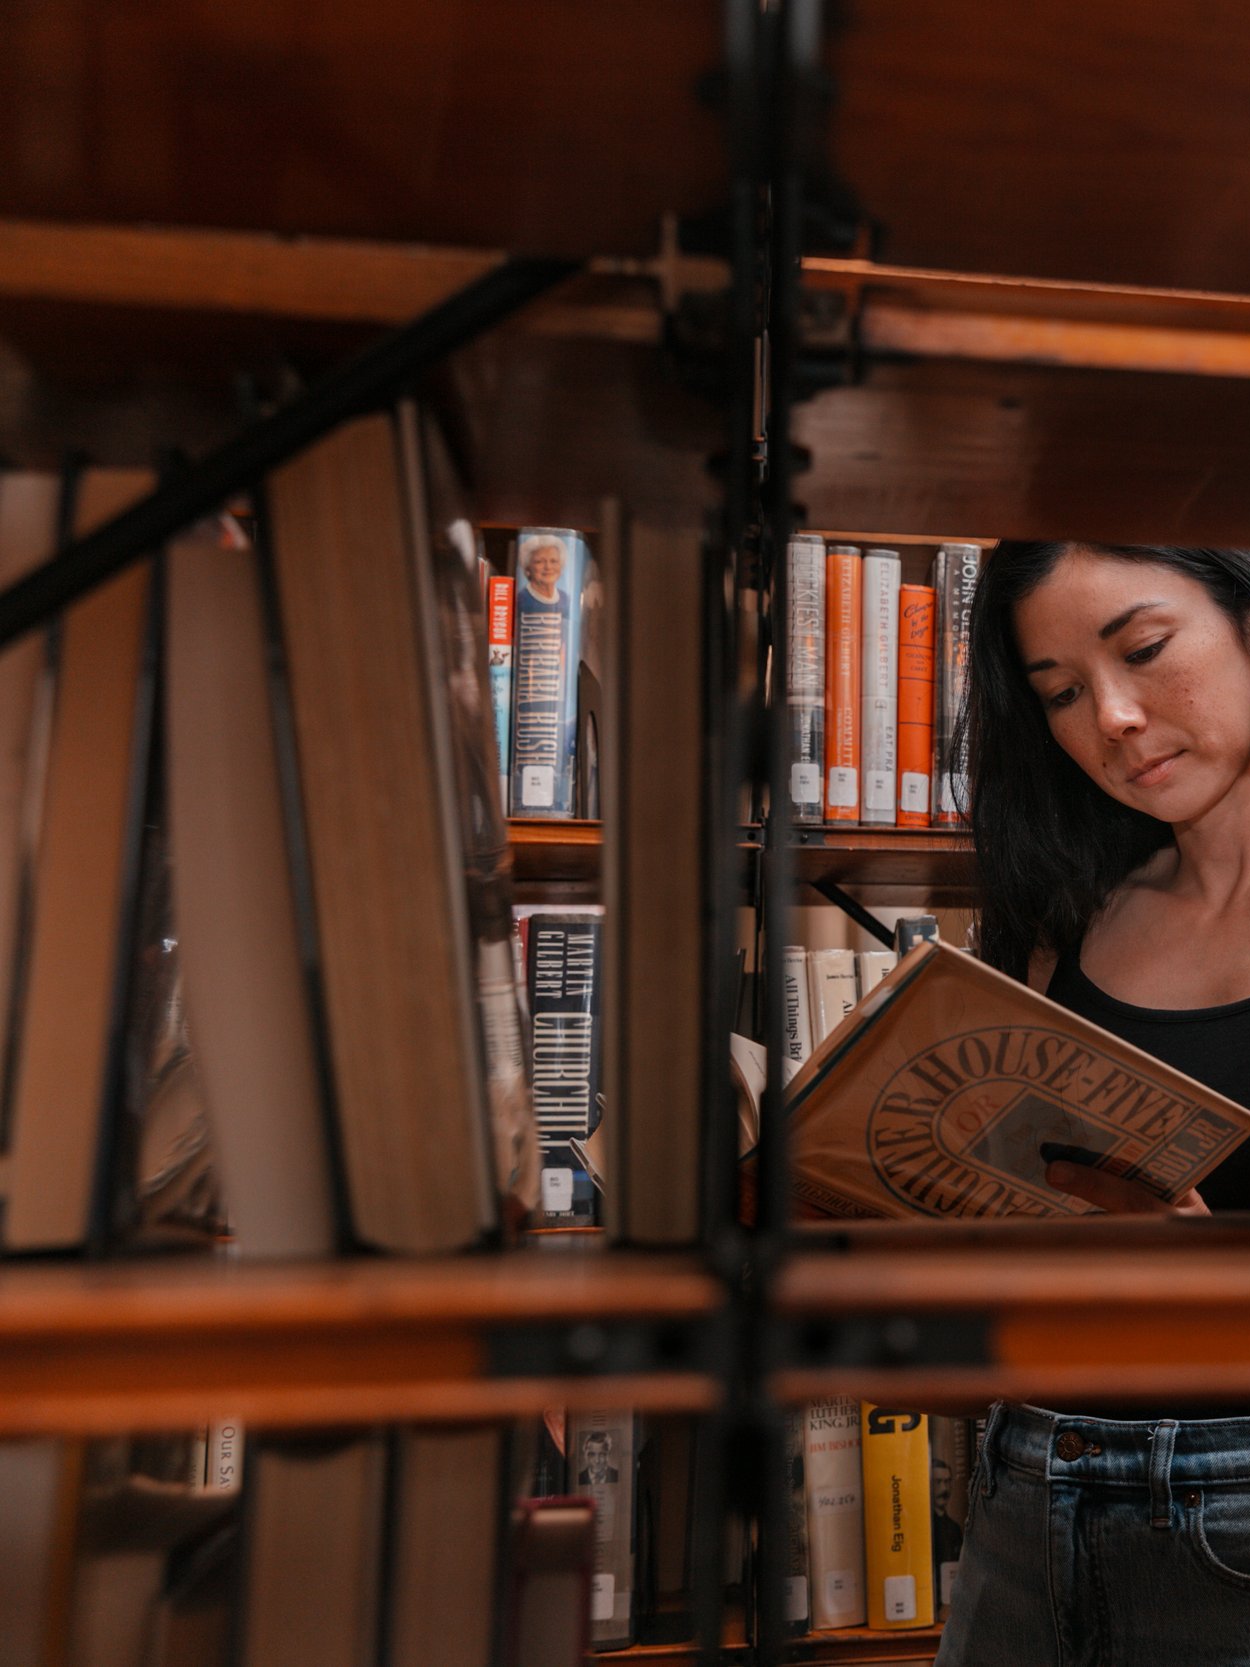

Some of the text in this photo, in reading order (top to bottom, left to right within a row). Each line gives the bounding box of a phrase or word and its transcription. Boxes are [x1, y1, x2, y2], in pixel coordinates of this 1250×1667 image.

[962, 555, 978, 604] JOHN
[879, 562, 890, 688] ELIZABETH GILBERT
[515, 611, 562, 767] BARBARA BUSH
[796, 645, 820, 687] MAN
[535, 930, 565, 998] GILBERT
[566, 933, 594, 997] MARTIN
[785, 974, 797, 994] All
[786, 996, 799, 1040] Things
[534, 1012, 592, 1154] CHURCHILL
[220, 1426, 235, 1460] OUR
[891, 1475, 904, 1553] Jonathan Eig
